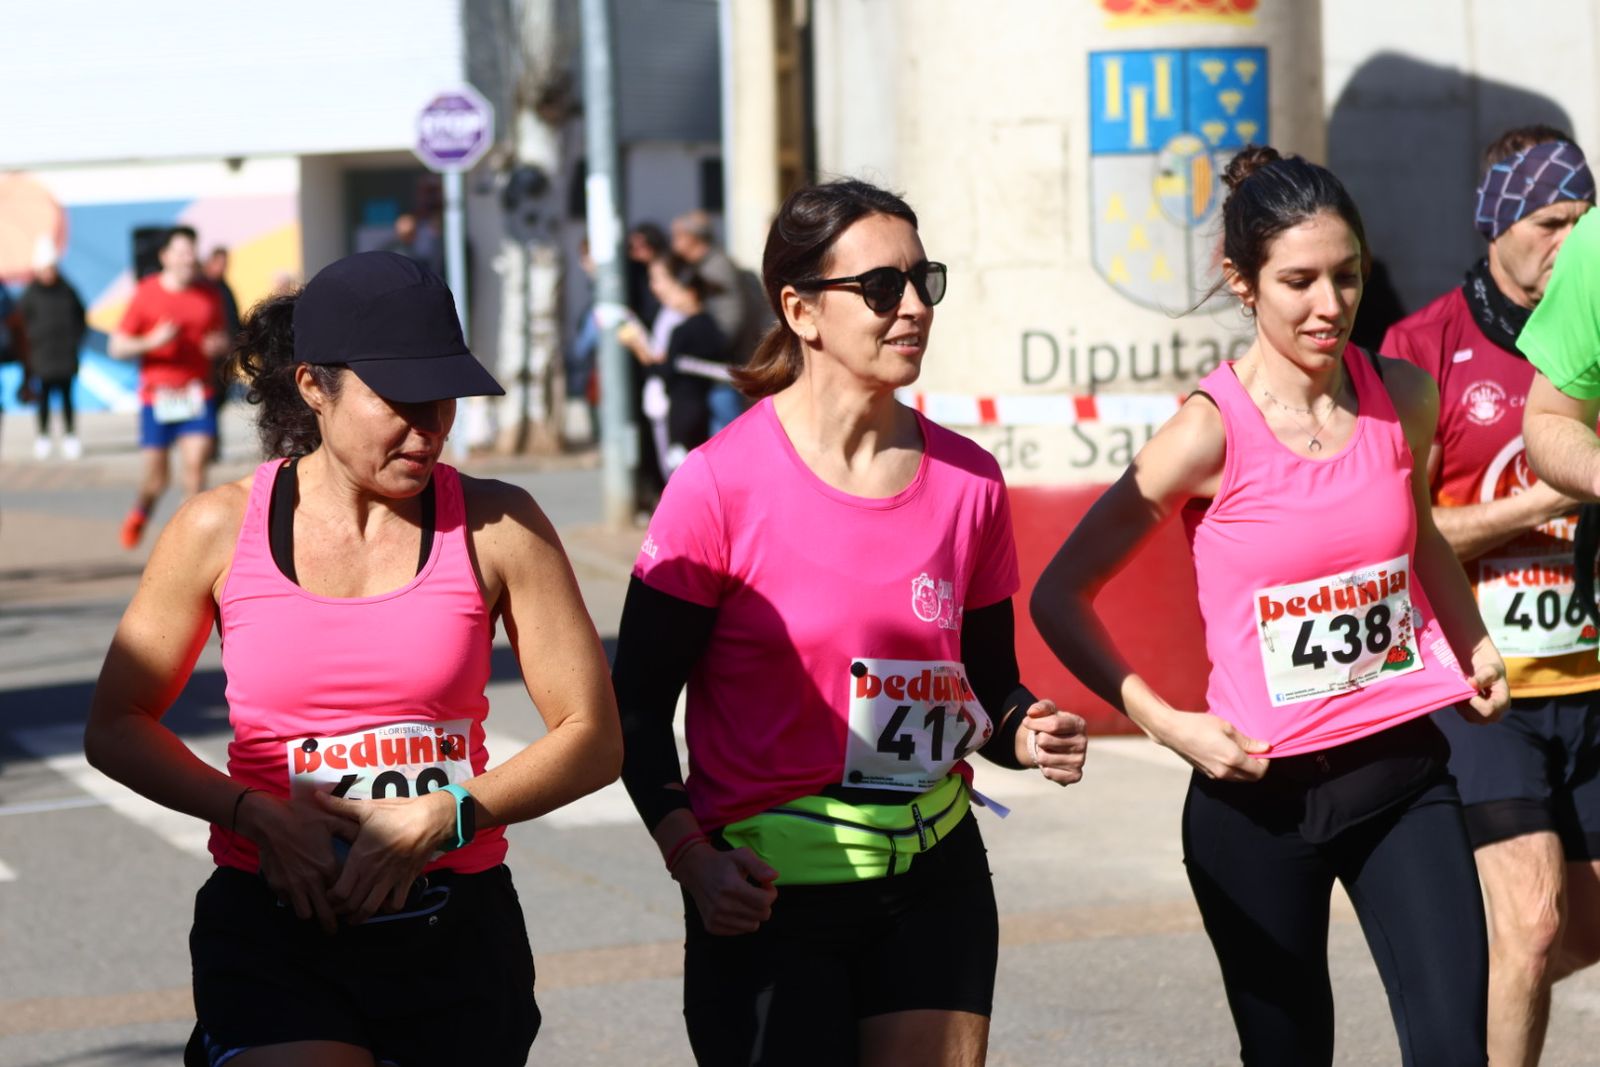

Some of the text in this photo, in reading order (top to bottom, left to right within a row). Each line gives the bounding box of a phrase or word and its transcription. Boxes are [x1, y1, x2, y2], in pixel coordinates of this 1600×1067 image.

[993, 425, 1041, 470] de
[1259, 570, 1406, 622] bedunia
[1504, 589, 1587, 632] 406
[1292, 604, 1392, 670] 438
[877, 705, 976, 761] 412
